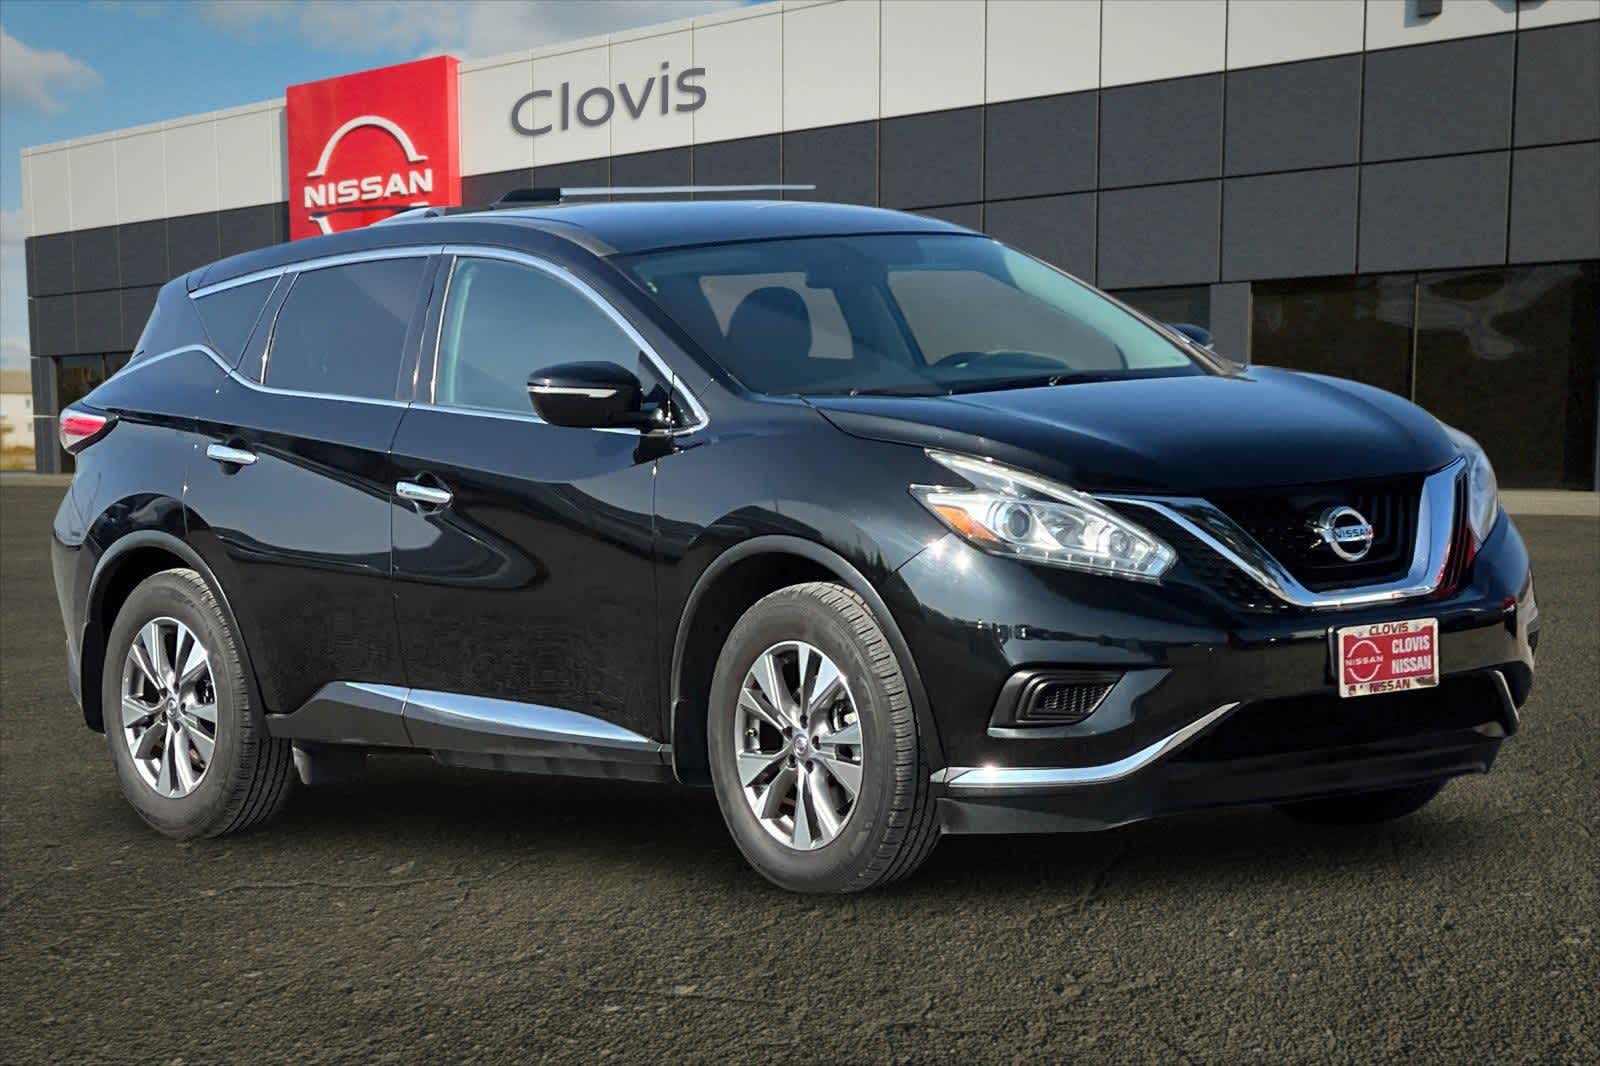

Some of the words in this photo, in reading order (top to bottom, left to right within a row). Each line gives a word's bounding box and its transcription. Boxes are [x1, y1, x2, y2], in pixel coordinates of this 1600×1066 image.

[511, 62, 708, 137] Clovis
[304, 168, 433, 208] NISSAN
[1333, 525, 1372, 539] NISSAN
[1369, 622, 1409, 636] CLOVIS
[1391, 635, 1430, 654] CLOVIS
[1345, 655, 1384, 667] NISSAN
[1391, 655, 1432, 675] NISSAN
[1368, 679, 1410, 693] NISSAN
